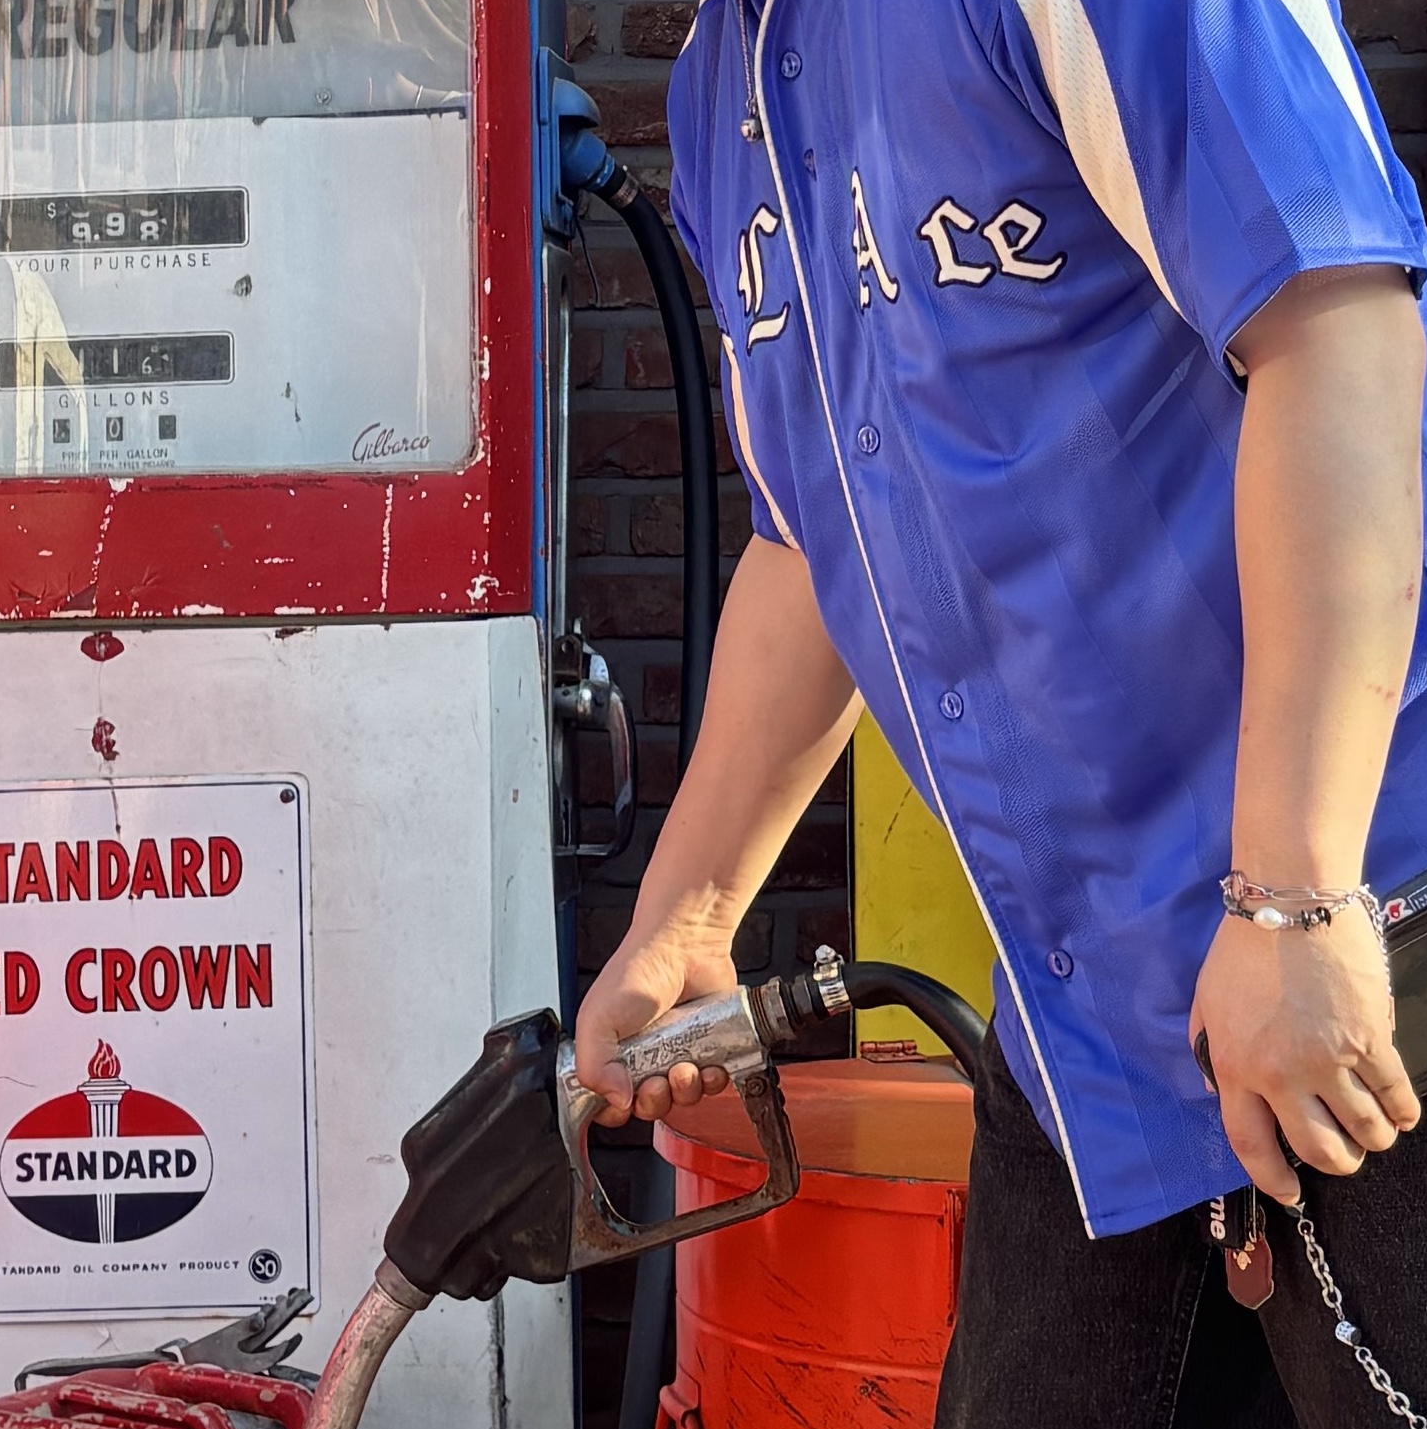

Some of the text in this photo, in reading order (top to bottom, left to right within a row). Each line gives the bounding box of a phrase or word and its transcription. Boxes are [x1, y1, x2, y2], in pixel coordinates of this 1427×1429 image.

[15, 252, 212, 273] YOUR PURCHASE
[59, 390, 170, 409] GALLONS
[127, 448, 168, 460] GALLON
[351, 423, 431, 464] Gilbarco
[65, 943, 273, 1015] CROWN
[15, 1148, 198, 1183] STANDARD
[73, 1264, 93, 1274] OIL
[102, 1262, 168, 1273] COMPANY
[179, 1260, 240, 1271] PRODUCT
